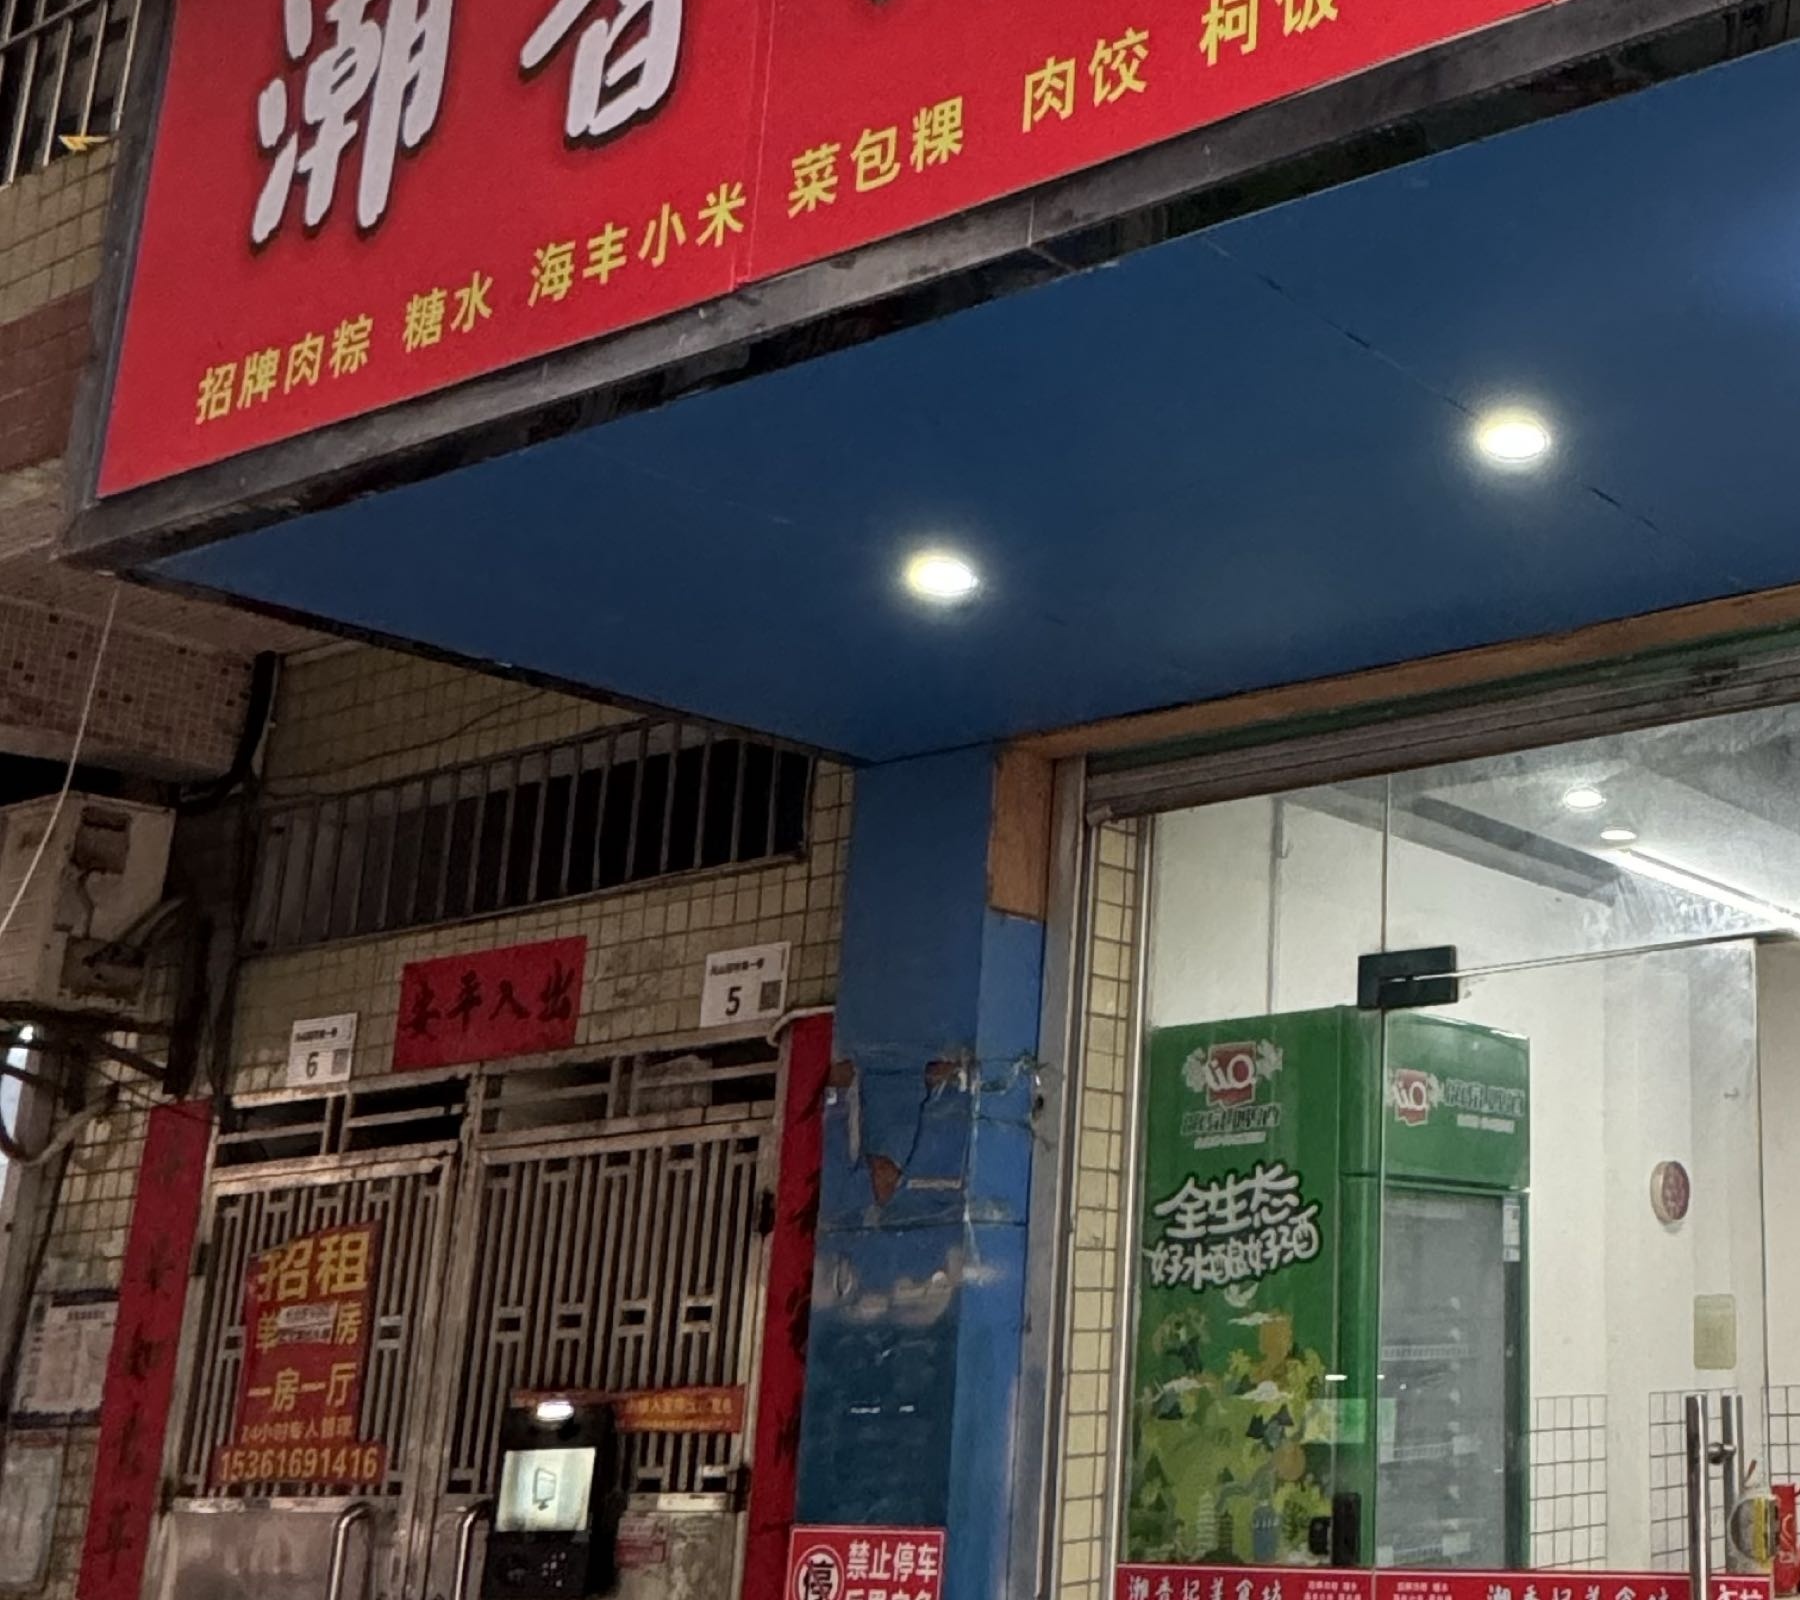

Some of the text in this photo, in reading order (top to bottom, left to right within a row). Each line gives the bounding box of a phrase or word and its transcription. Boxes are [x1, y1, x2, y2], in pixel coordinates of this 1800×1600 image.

[196, 316, 375, 424] 招牌肉粽
[402, 274, 493, 352] 糖水
[528, 182, 747, 304] 海丰小米
[788, 98, 967, 219] 菜包粿
[1020, 28, 1152, 133] 肉饺
[724, 985, 744, 1017] 5
[306, 1051, 319, 1079] 6
[1153, 1162, 1300, 1238] 全生态
[257, 1231, 371, 1301] 招租
[1148, 1203, 1321, 1289] 好水酿好酒
[248, 1362, 358, 1413] 一房一厅
[221, 1446, 379, 1482] 15361691416
[846, 1538, 939, 1583] 禁止停车
